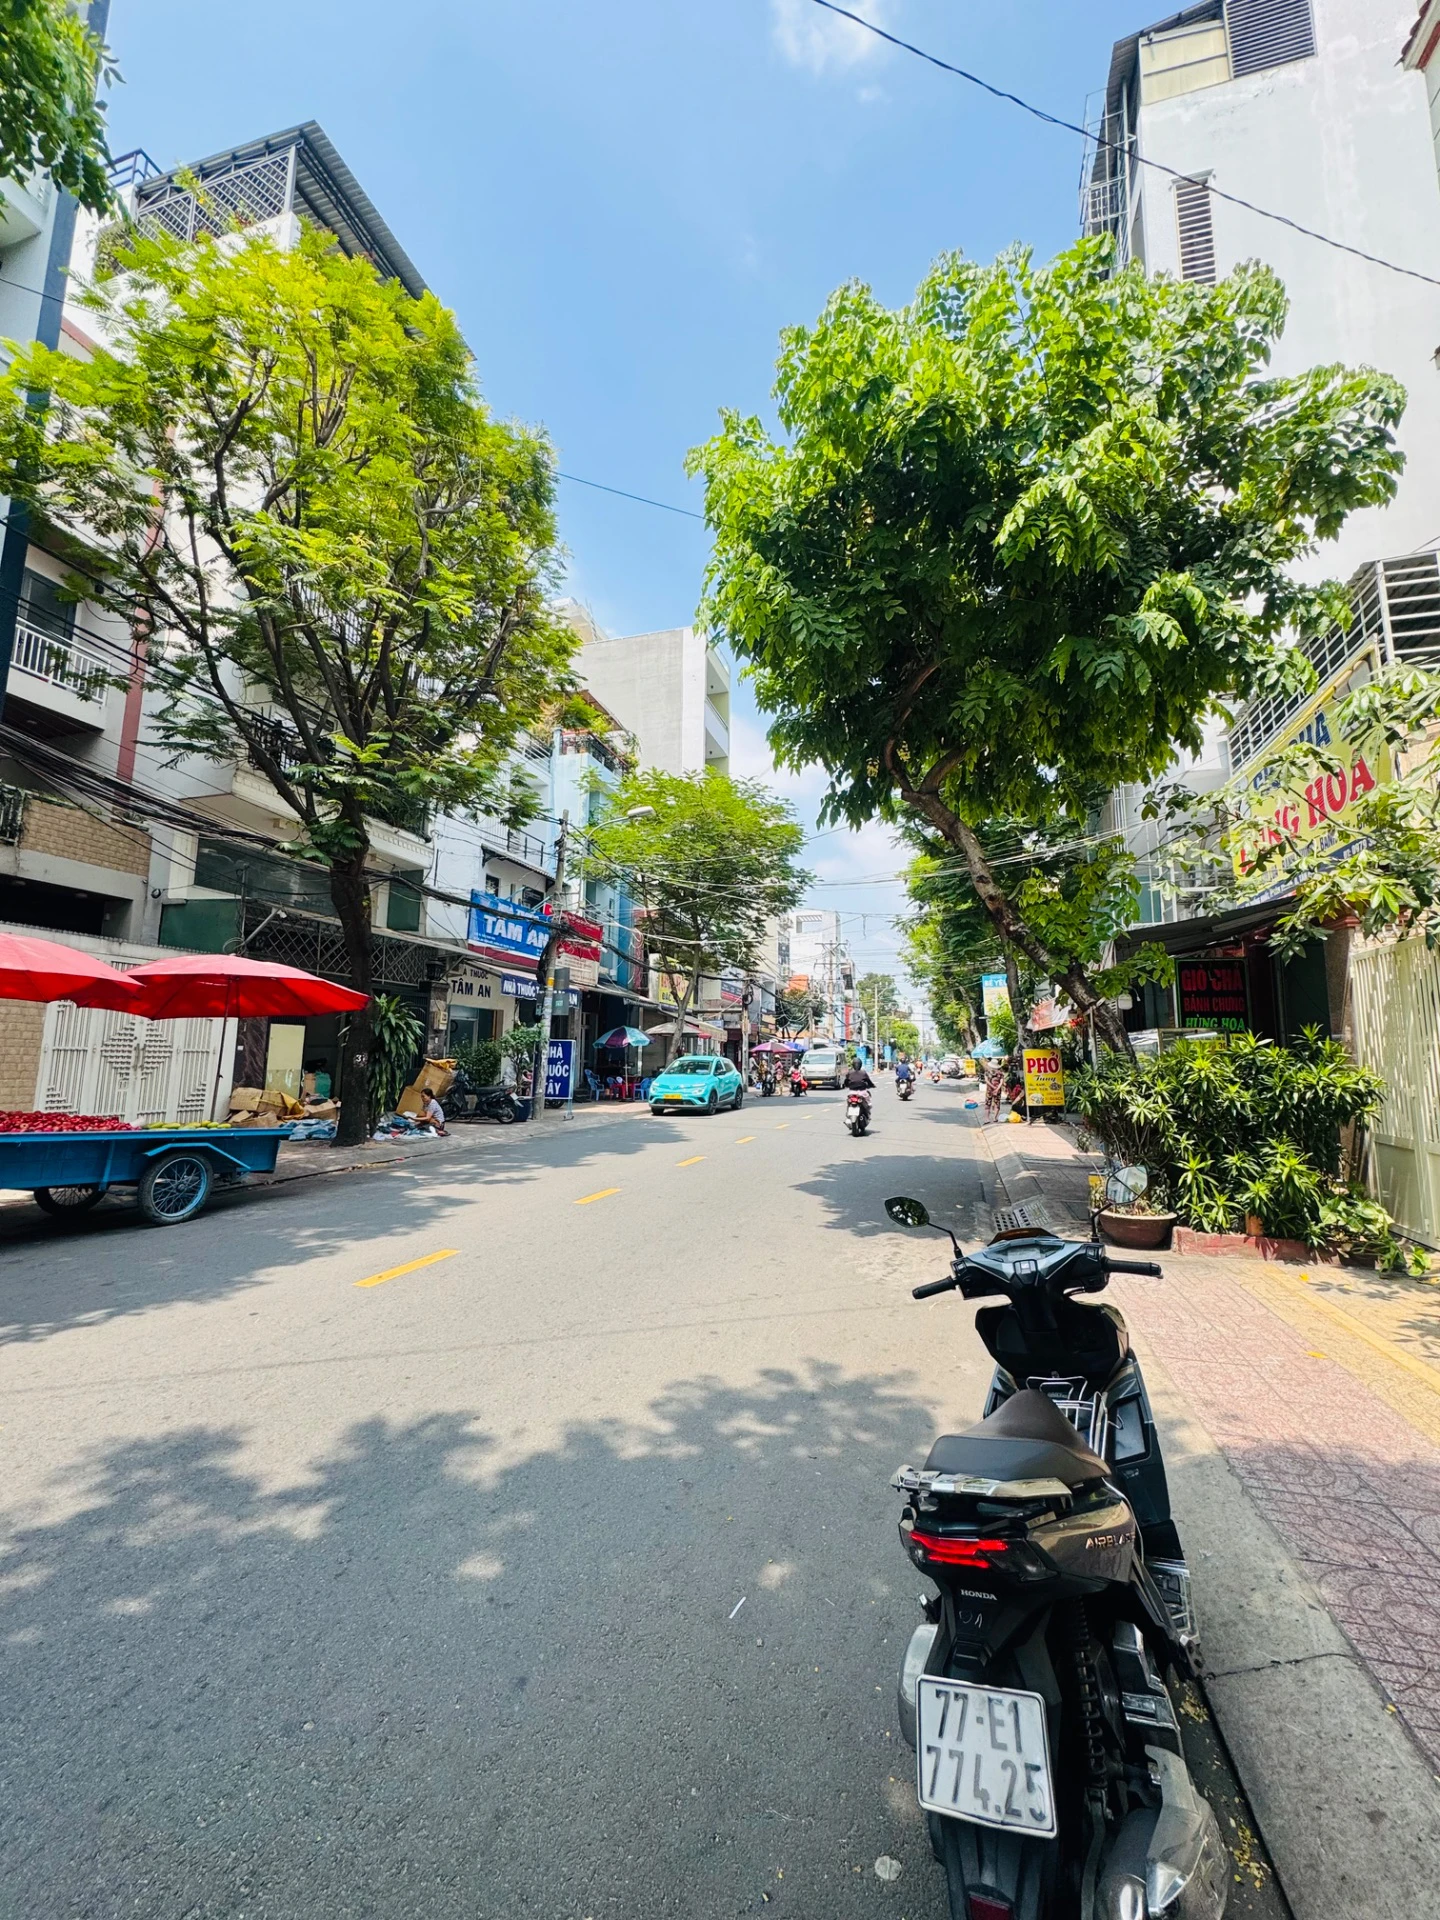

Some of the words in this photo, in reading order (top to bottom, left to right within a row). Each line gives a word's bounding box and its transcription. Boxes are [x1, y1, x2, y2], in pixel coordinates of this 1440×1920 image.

[1304, 749, 1376, 830] HOA
[451, 977, 473, 996] TÂM
[477, 983, 492, 998] AN
[1181, 964, 1207, 991] GIÒ
[1221, 1017, 1245, 1031] HOA
[550, 1043, 563, 1059] HÀ
[546, 1060, 570, 1078] UỐC
[1026, 1051, 1059, 1074] PHỞ
[960, 1589, 998, 1601] HONDA
[926, 1745, 1046, 1822] 774.25
